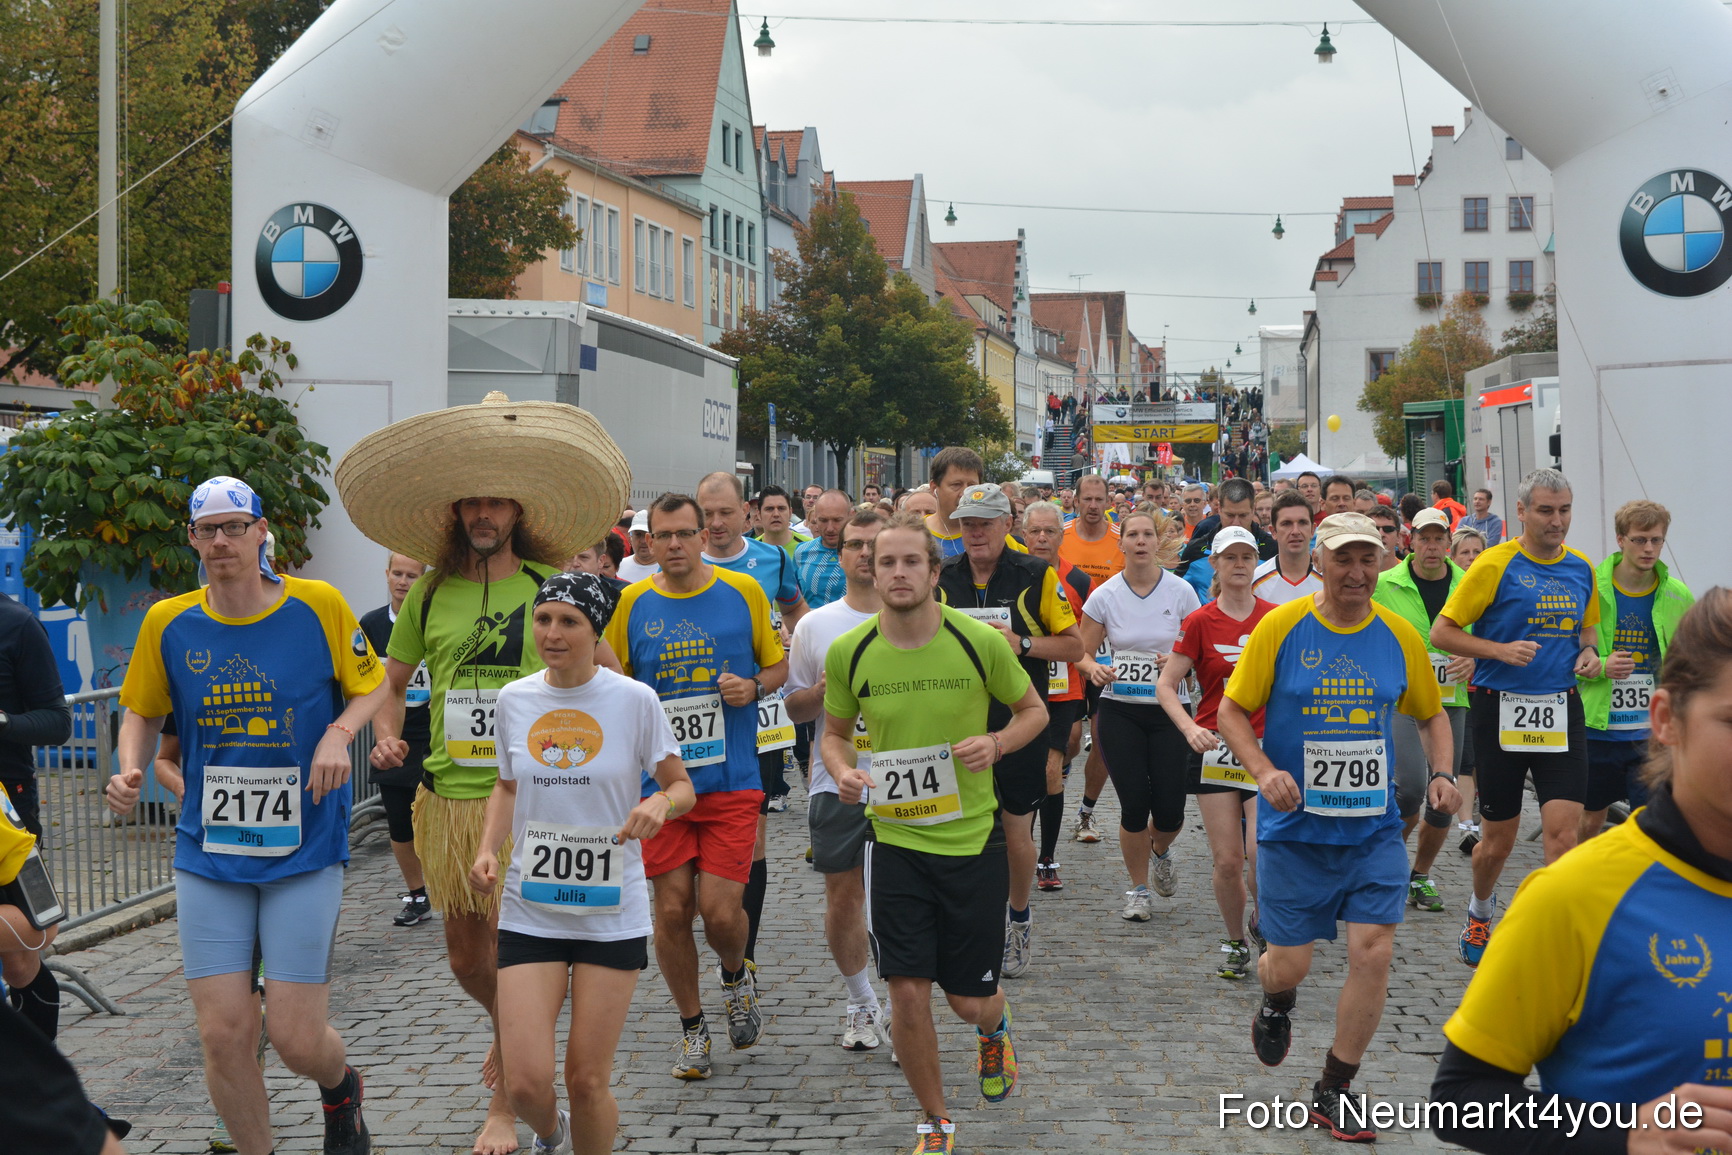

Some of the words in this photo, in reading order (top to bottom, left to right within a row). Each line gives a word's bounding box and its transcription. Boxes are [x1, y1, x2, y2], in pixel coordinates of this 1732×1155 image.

[1629, 172, 1732, 215] BMW
[262, 205, 354, 244] BMW
[703, 398, 731, 442] BOCK
[1133, 428, 1176, 439] START
[457, 669, 520, 679] METRAWATT
[872, 681, 910, 697] GOSSEN
[913, 678, 971, 692] METRAWATT
[1127, 686, 1152, 696] Sabine
[447, 697, 474, 705] PARTL
[674, 702, 709, 713] Neumarkt
[206, 707, 254, 716] 21.September
[1514, 706, 1555, 729] 248
[1610, 715, 1639, 723] Nathan
[203, 741, 291, 749] www.stadtlauf-neumarkt.de
[1523, 734, 1545, 743] Mark
[1306, 748, 1334, 757] PARTL
[1336, 748, 1373, 757] Neumarkt
[871, 758, 895, 769] PARTL
[896, 754, 937, 766] Neumarkt
[1224, 771, 1245, 783] Patty
[1313, 758, 1379, 788] 2798
[206, 775, 235, 786] PARTL
[237, 776, 282, 786] Neumarkt
[533, 775, 590, 787] Ingolstadt
[885, 766, 940, 801] 214
[212, 789, 292, 822] 2174
[1321, 794, 1371, 809] Wolfgang
[895, 803, 938, 818] Bastian
[238, 830, 264, 847] Jörg
[527, 830, 558, 842] PARTL
[561, 832, 608, 844] Neumarkt
[531, 845, 611, 881] 2091
[554, 889, 586, 903] Julia
[1671, 939, 1687, 950] 15
[1665, 954, 1701, 965] Jahre
